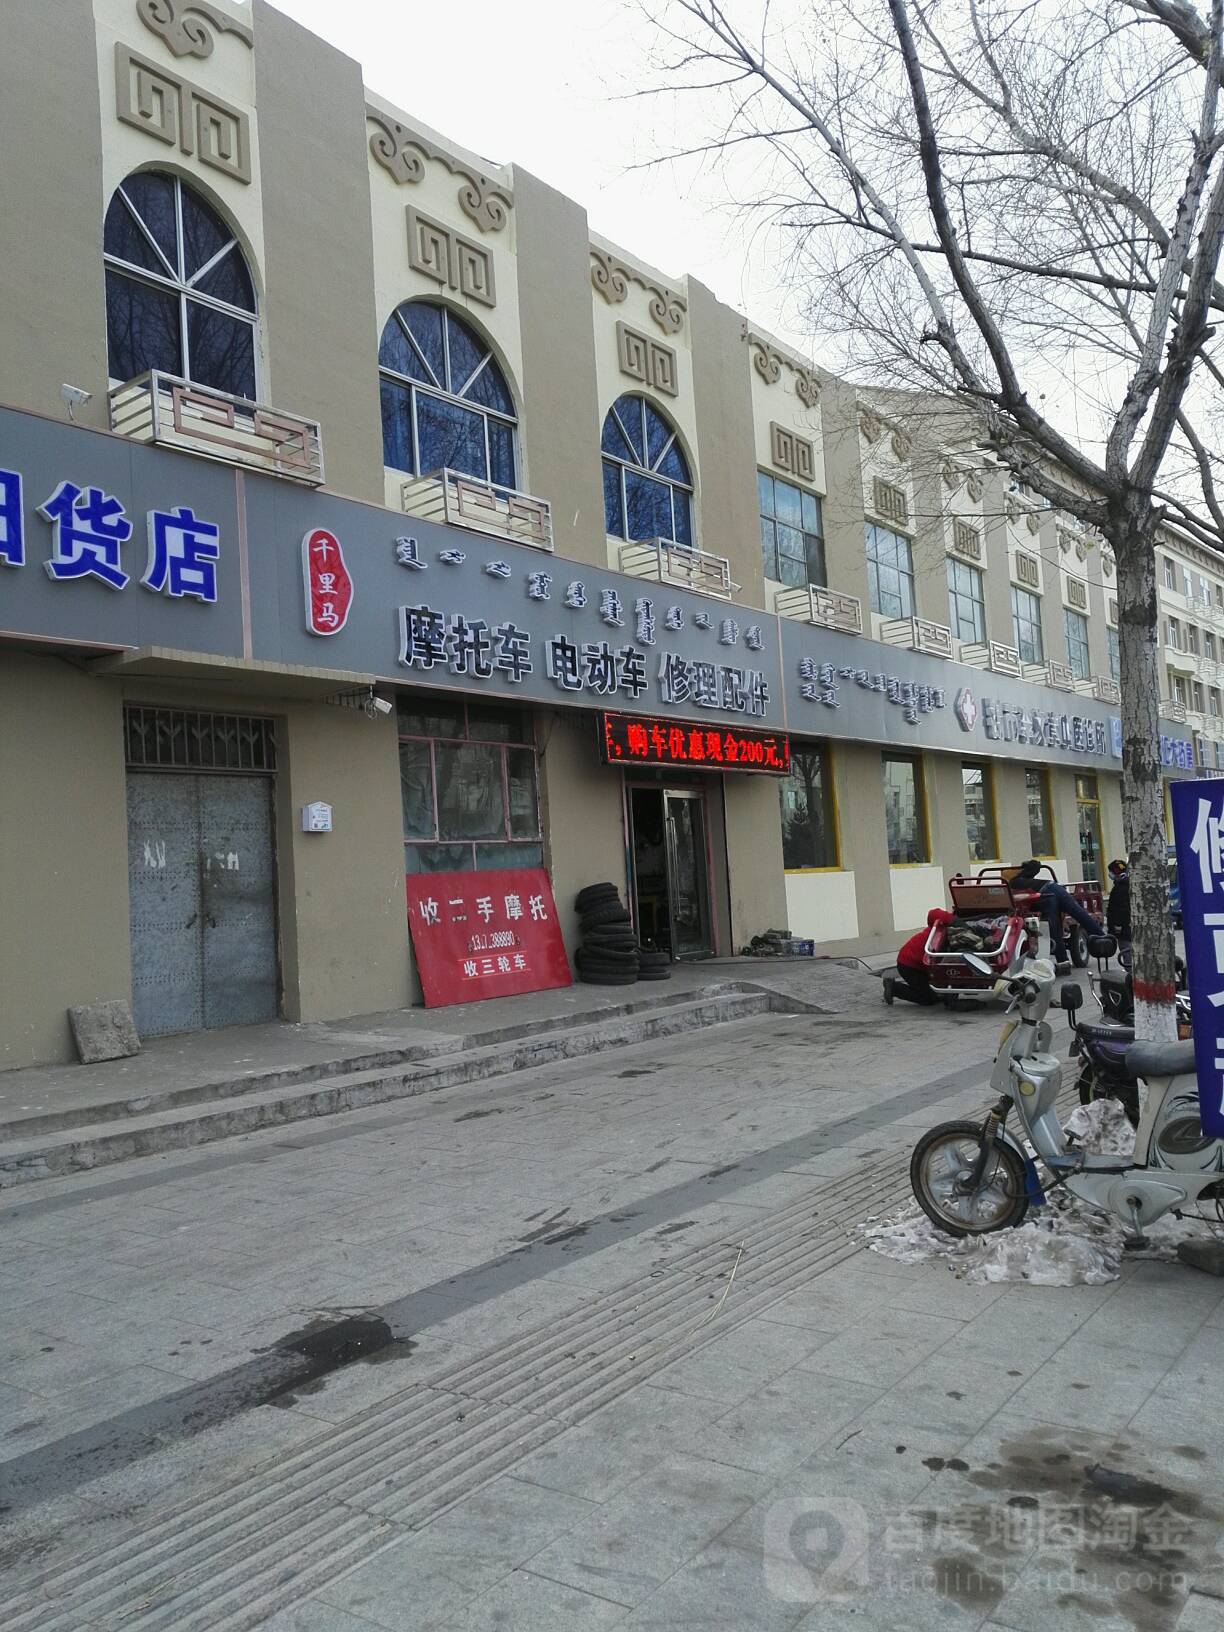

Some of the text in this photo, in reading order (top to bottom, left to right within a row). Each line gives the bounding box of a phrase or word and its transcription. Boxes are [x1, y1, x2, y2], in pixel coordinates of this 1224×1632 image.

[311, 536, 340, 629] 千里马
[398, 604, 533, 683] 摩托车
[545, 632, 649, 699] 电动车
[657, 651, 770, 718] 修理配件
[463, 953, 527, 977] 收三轮车
